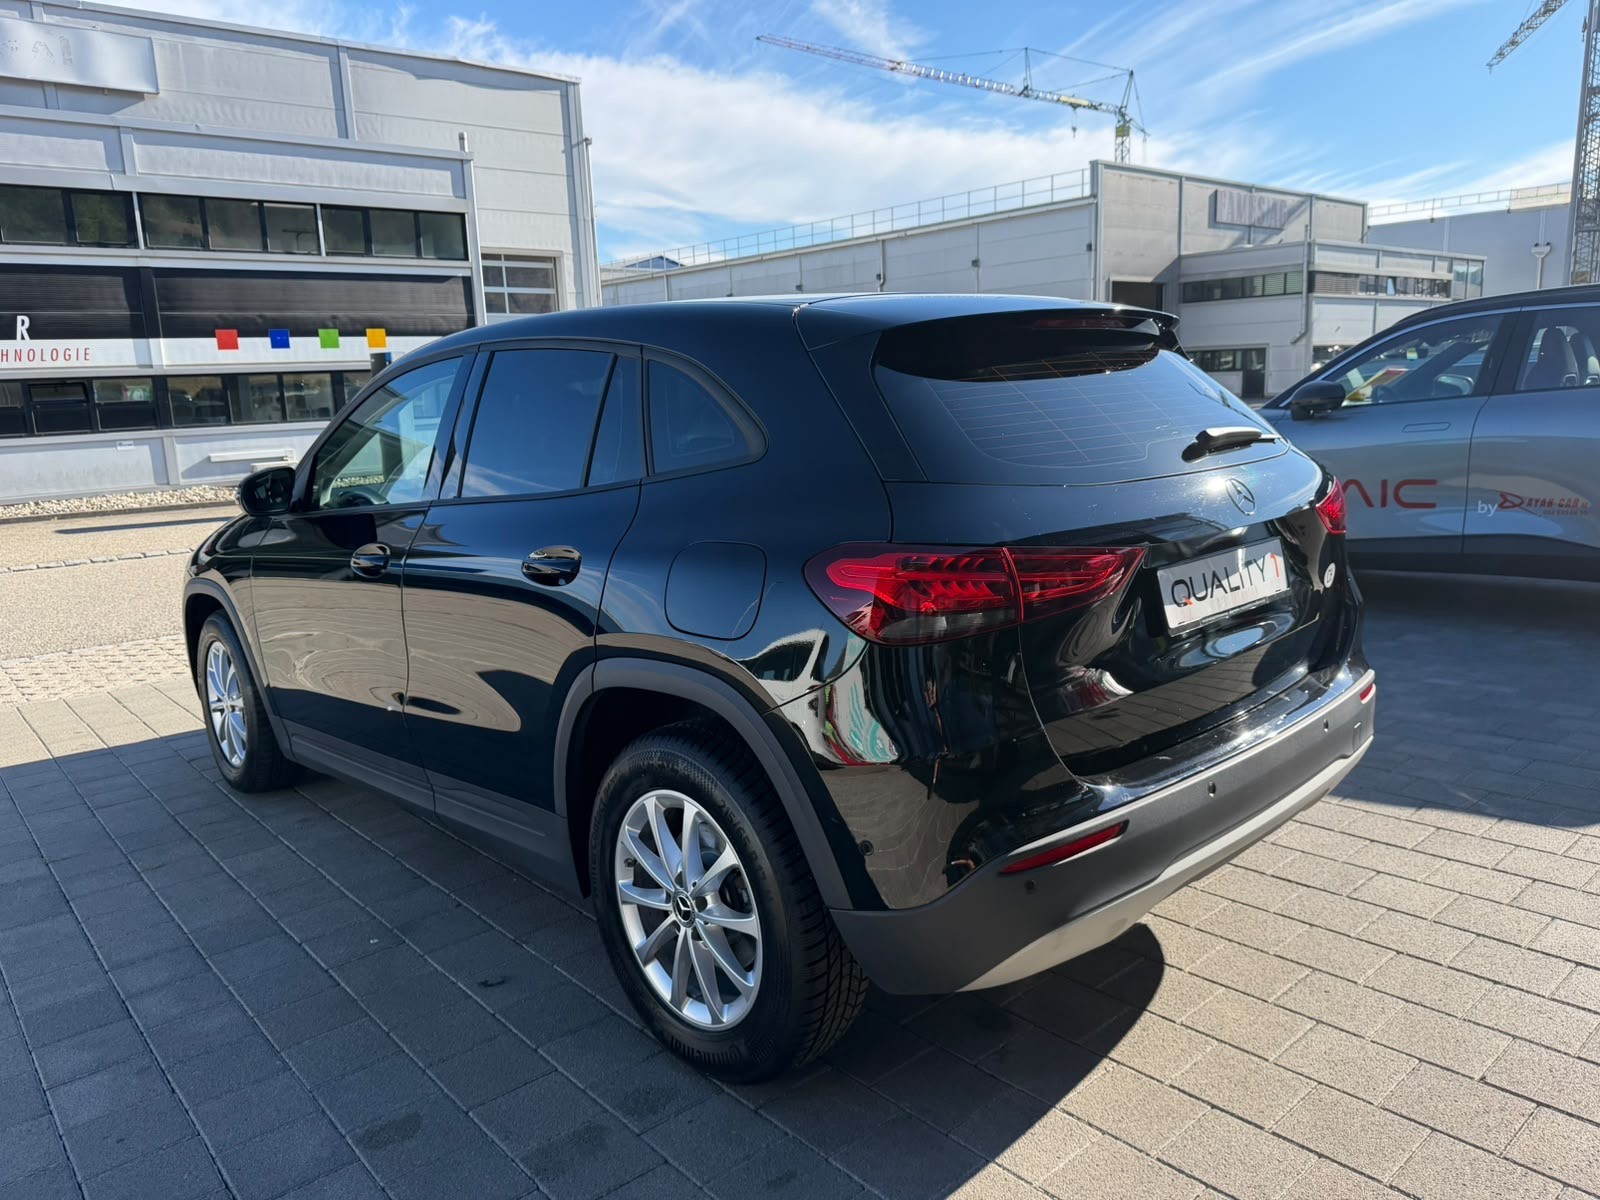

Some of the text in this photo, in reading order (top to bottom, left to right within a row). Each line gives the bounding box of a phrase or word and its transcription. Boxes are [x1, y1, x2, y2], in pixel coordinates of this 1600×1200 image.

[16, 315, 30, 340] R
[1, 347, 90, 362] HNOLOGIE
[1477, 500, 1498, 517] by
